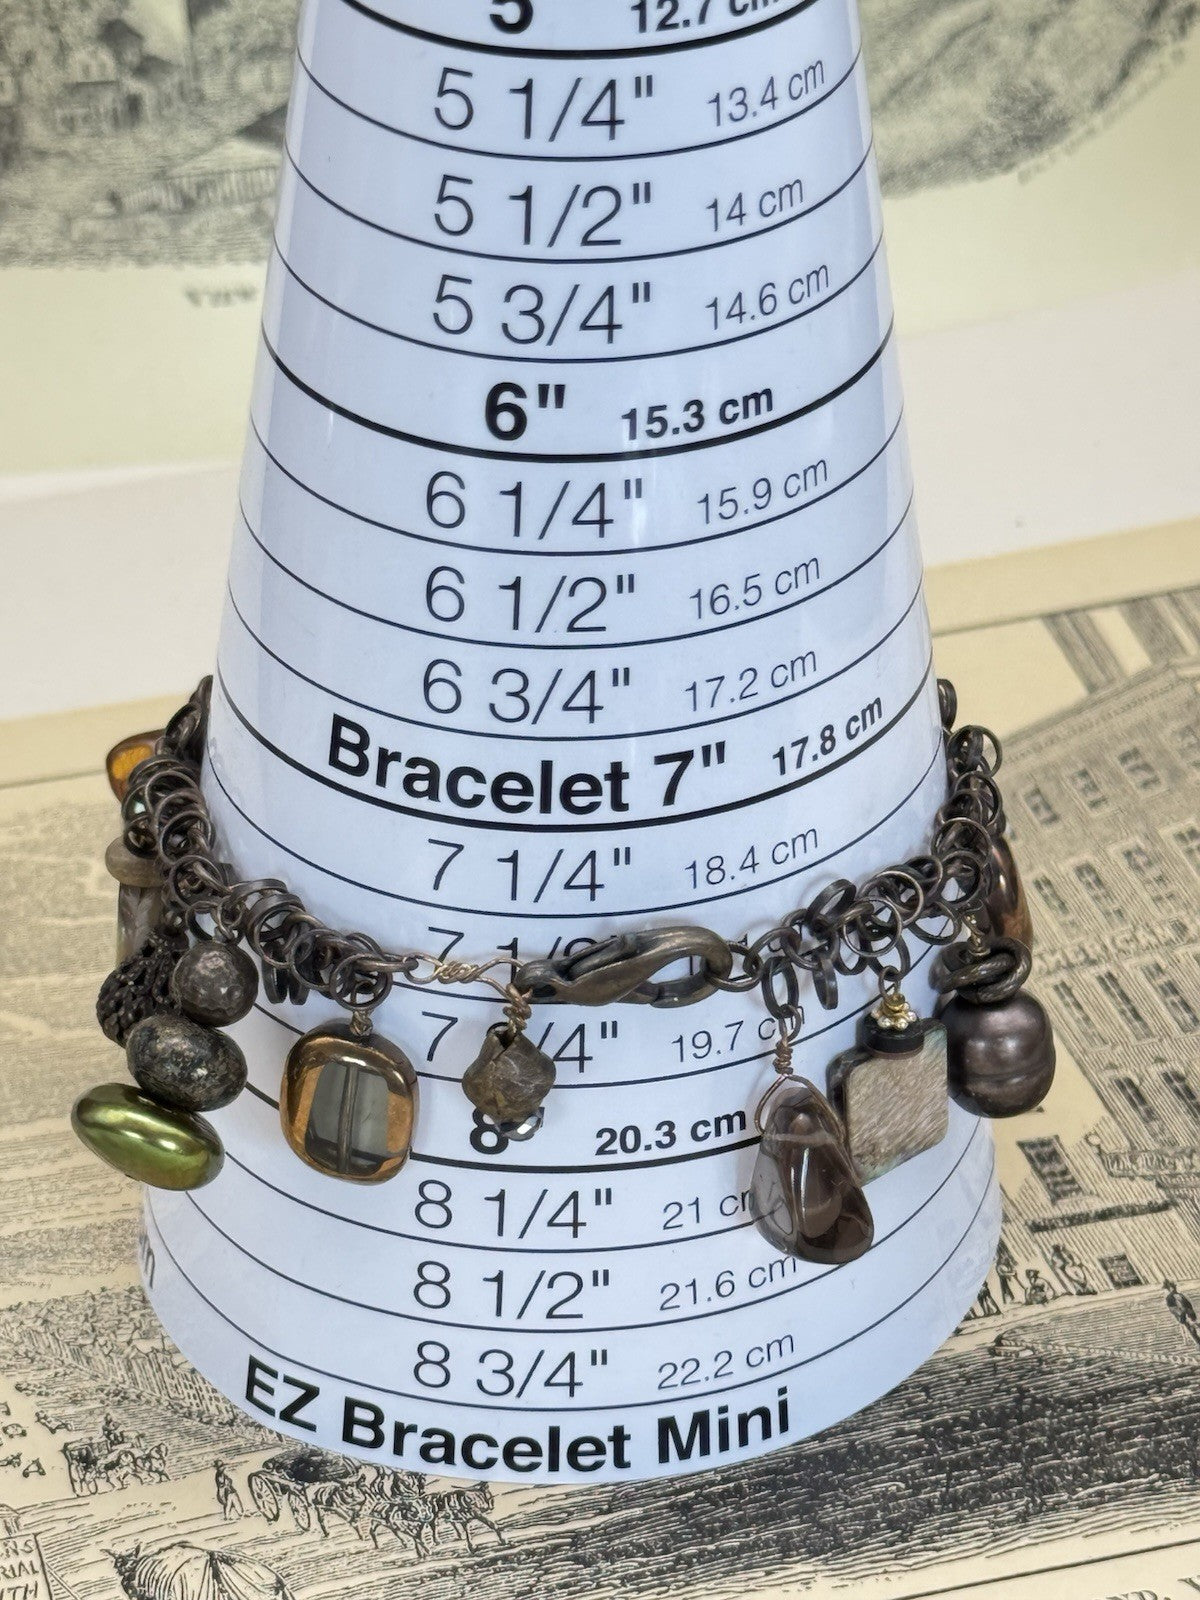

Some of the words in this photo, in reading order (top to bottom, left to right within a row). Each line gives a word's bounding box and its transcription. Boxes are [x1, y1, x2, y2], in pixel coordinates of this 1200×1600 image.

[630, 0, 712, 34] 12.7
[433, 66, 475, 132] 5
[508, 74, 654, 142] 1/4"
[707, 75, 779, 127] 13.4
[787, 59, 825, 102] cm
[433, 173, 475, 237] 5
[507, 180, 652, 249] 1/2"
[705, 190, 747, 233] 14
[758, 178, 804, 218] cm
[432, 273, 474, 336] 5
[500, 280, 652, 347] 3/4"
[704, 281, 778, 331] 14.6
[788, 263, 830, 306] cm
[484, 381, 567, 442] 6"
[620, 398, 706, 441] 15.3
[718, 387, 774, 426] cm
[425, 470, 466, 530] 6
[498, 477, 643, 541] 1/4"
[696, 477, 773, 525] 15.9
[783, 458, 829, 499] cm
[425, 565, 466, 623] 6
[497, 573, 636, 634] 1/2"
[688, 572, 763, 620] 16.5
[774, 557, 821, 596] cm
[422, 658, 463, 715] 6
[488, 666, 631, 726] 3/4"
[684, 666, 759, 713] 17.2
[770, 650, 817, 689] cm
[327, 711, 631, 816] Bracelet
[653, 739, 728, 808] 7"
[770, 723, 837, 777] 17.8
[844, 696, 884, 742] cm
[427, 838, 465, 892] 7
[496, 846, 632, 904] 1/4"
[684, 844, 760, 890] 18.4
[771, 827, 819, 866] cm
[421, 1010, 459, 1063] 7
[671, 1019, 745, 1064] 19.7
[594, 1119, 678, 1157] 20.3
[689, 1108, 748, 1143] cm
[414, 1178, 453, 1230] 8
[483, 1186, 613, 1240] 1/4"
[662, 1196, 701, 1231] 21
[412, 1259, 452, 1310] 8
[482, 1268, 611, 1321] 1/2"
[658, 1269, 736, 1312] 21.6
[747, 1255, 798, 1289] cm
[412, 1339, 452, 1389] 8
[475, 1348, 608, 1400] 3/4"
[657, 1349, 734, 1391] 22.2
[745, 1332, 795, 1369] cm
[244, 1353, 321, 1434] EZ
[341, 1395, 632, 1473] Bracelet
[657, 1385, 790, 1465] Mini
